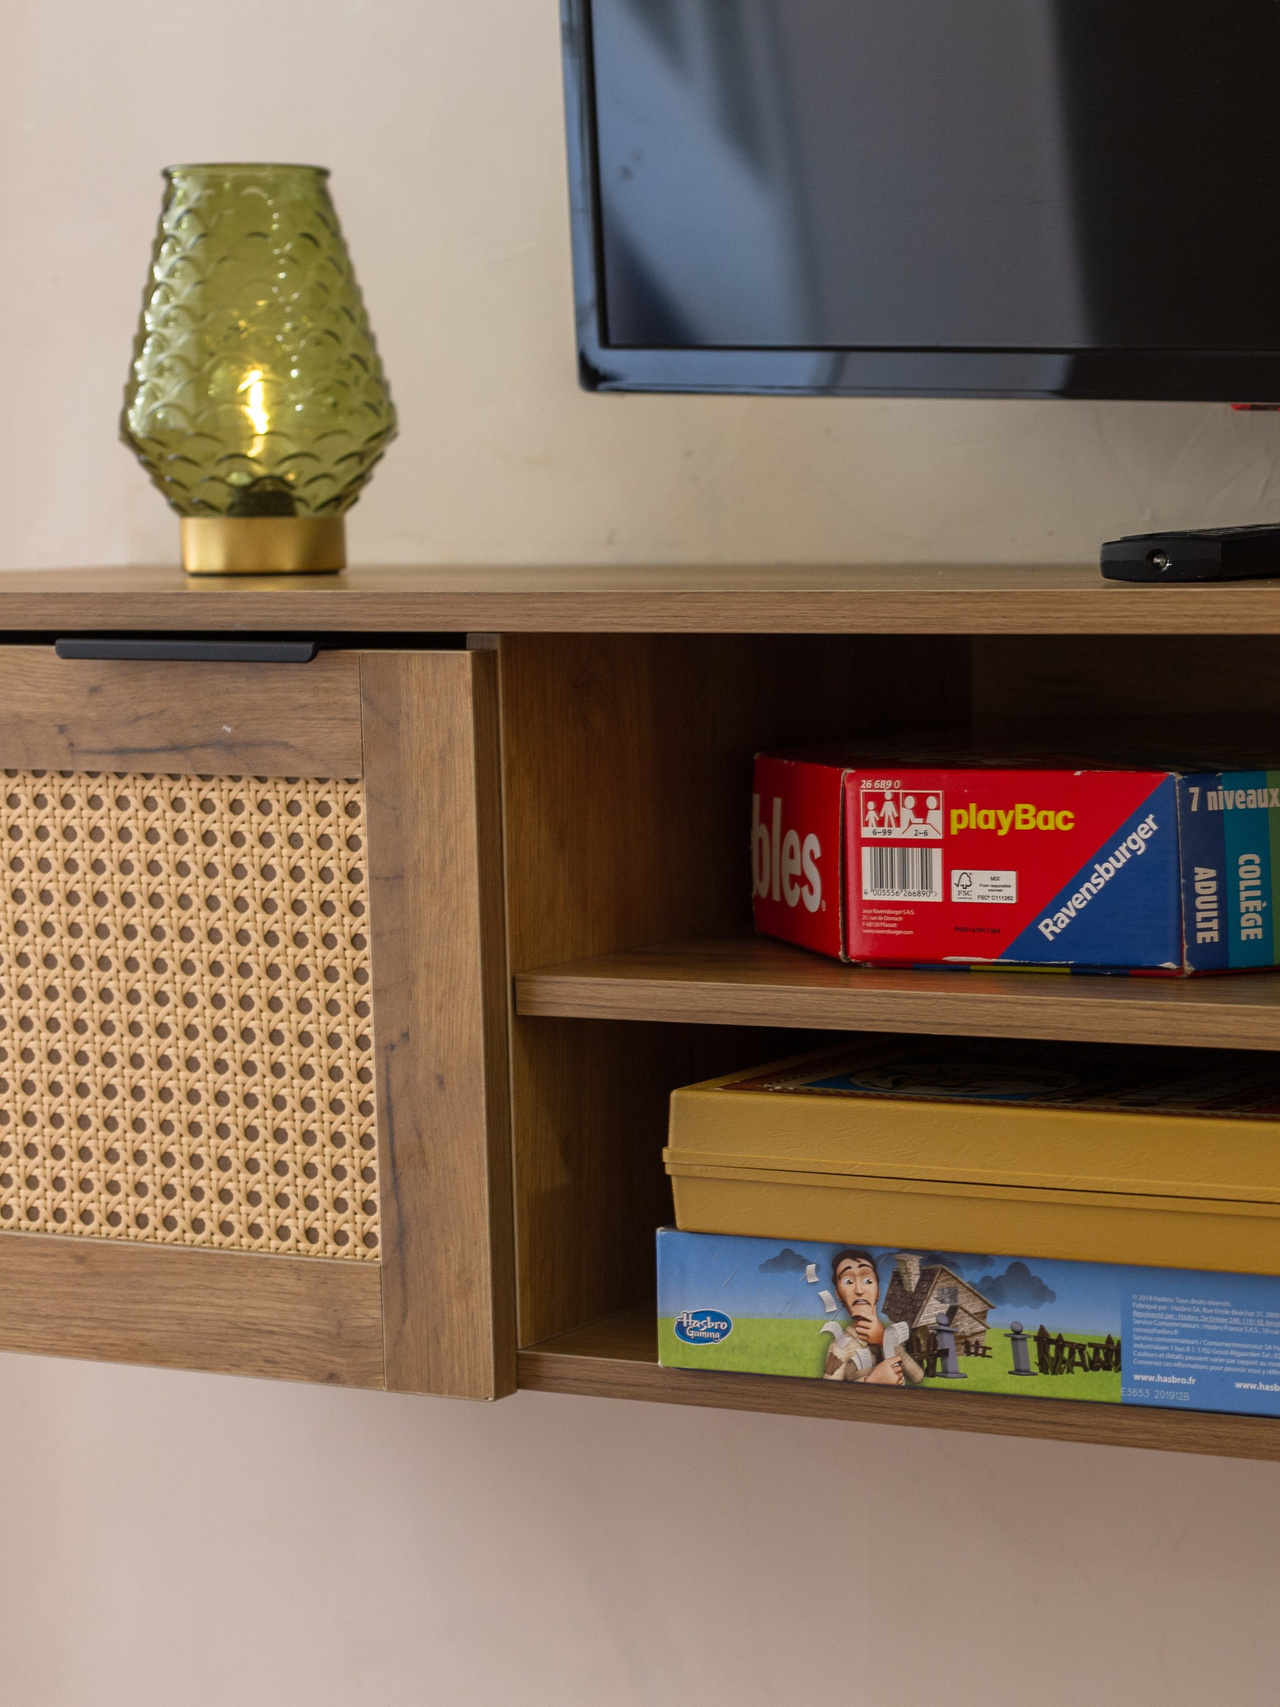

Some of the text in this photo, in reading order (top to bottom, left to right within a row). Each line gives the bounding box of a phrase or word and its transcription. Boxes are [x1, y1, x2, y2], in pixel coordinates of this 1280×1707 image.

[861, 779, 901, 789] 26 689 0
[1189, 787, 1199, 812] 7
[1207, 785, 1280, 811] niveaux
[950, 803, 1075, 836] playBac
[1037, 813, 1160, 941] Ravensburger
[872, 889, 900, 897] 005556
[903, 889, 931, 898] 266890
[1238, 853, 1263, 941] COLLÈGE
[1193, 867, 1219, 944] ADULTE
[677, 1312, 728, 1331] Hasbro
[1153, 1319, 1199, 1329] Consommateurs
[686, 1326, 719, 1342] Gaming
[1154, 1336, 1198, 1345] consommateurs
[1132, 1350, 1158, 1358] Couleurs
[1184, 1354, 1208, 1362] peuvent
[1132, 1358, 1162, 1367] Conservez
[1172, 1361, 1208, 1370] informations
[1224, 1365, 1246, 1373] pouvoir
[1133, 1374, 1196, 1385] www.hasbro.fr
[1154, 1389, 1190, 1401] 201912B
